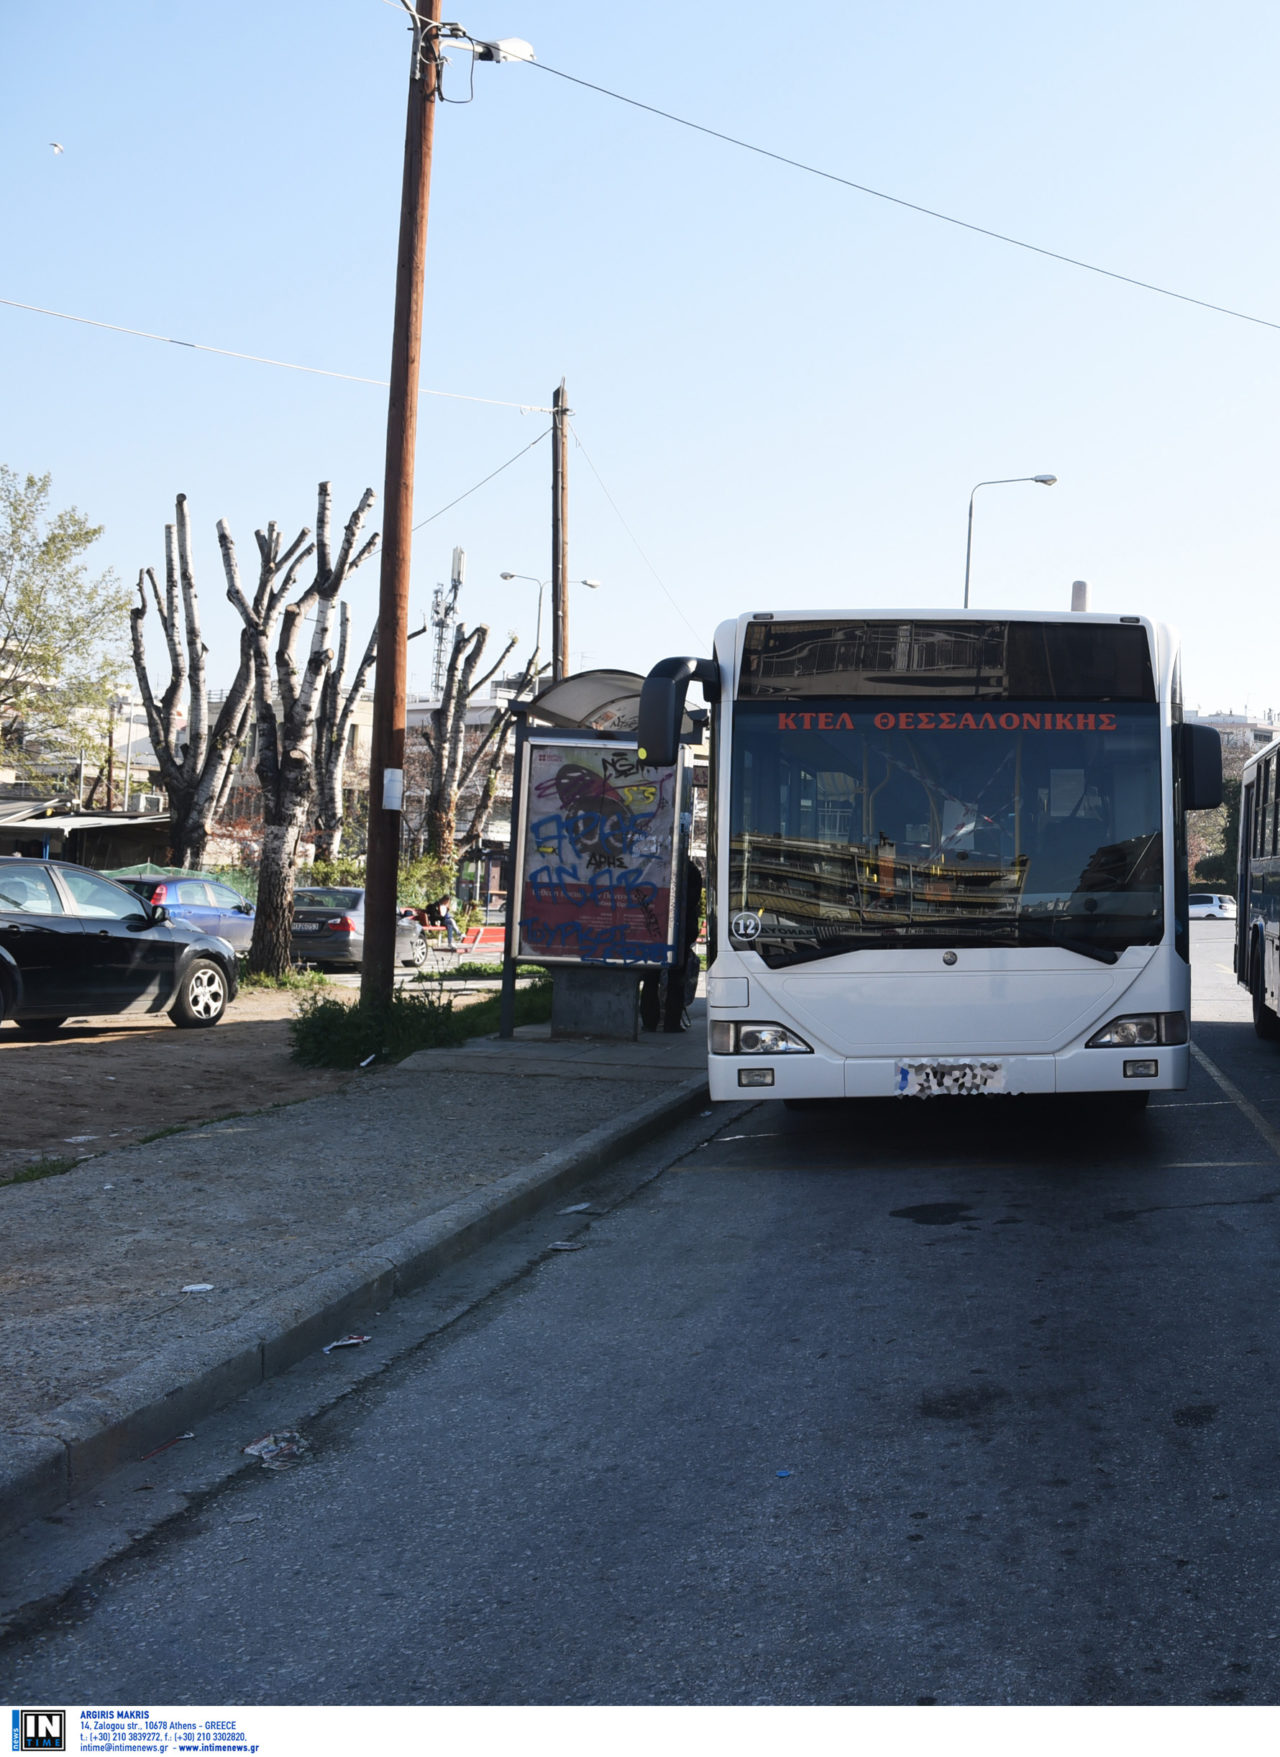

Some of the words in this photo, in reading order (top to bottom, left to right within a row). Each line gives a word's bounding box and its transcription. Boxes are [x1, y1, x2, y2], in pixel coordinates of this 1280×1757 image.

[777, 712, 855, 730] ΚΤΕΛ
[873, 712, 1118, 731] ΘΕΣΣΑΛΟΝΙΚΗΣ
[738, 919, 756, 934] 12
